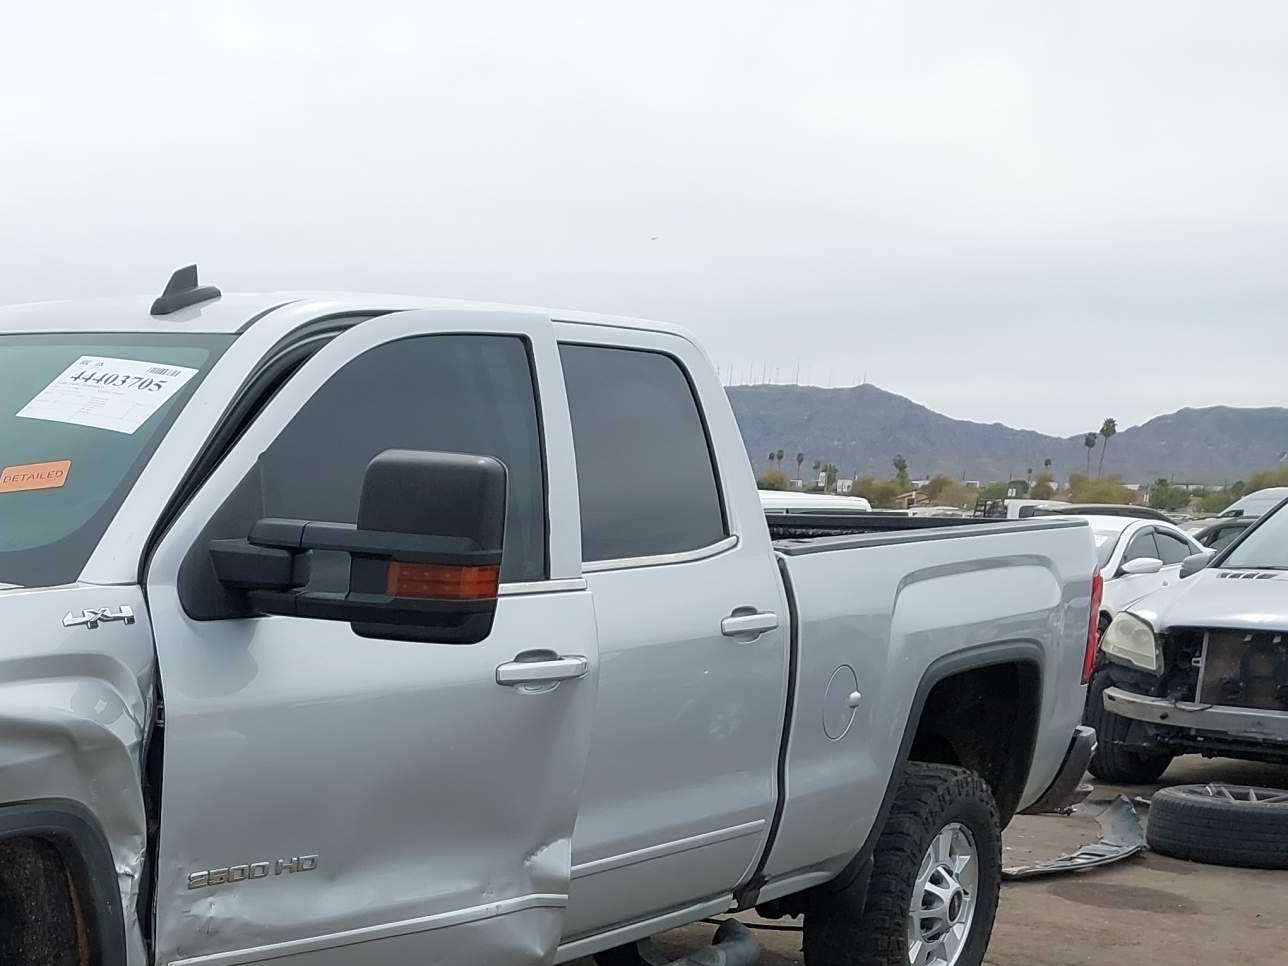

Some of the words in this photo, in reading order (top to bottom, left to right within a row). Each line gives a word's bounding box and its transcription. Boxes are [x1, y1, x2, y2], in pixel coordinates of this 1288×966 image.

[70, 369, 168, 392] 44403705
[3, 470, 64, 484] DETAILED
[275, 854, 320, 876] HD
